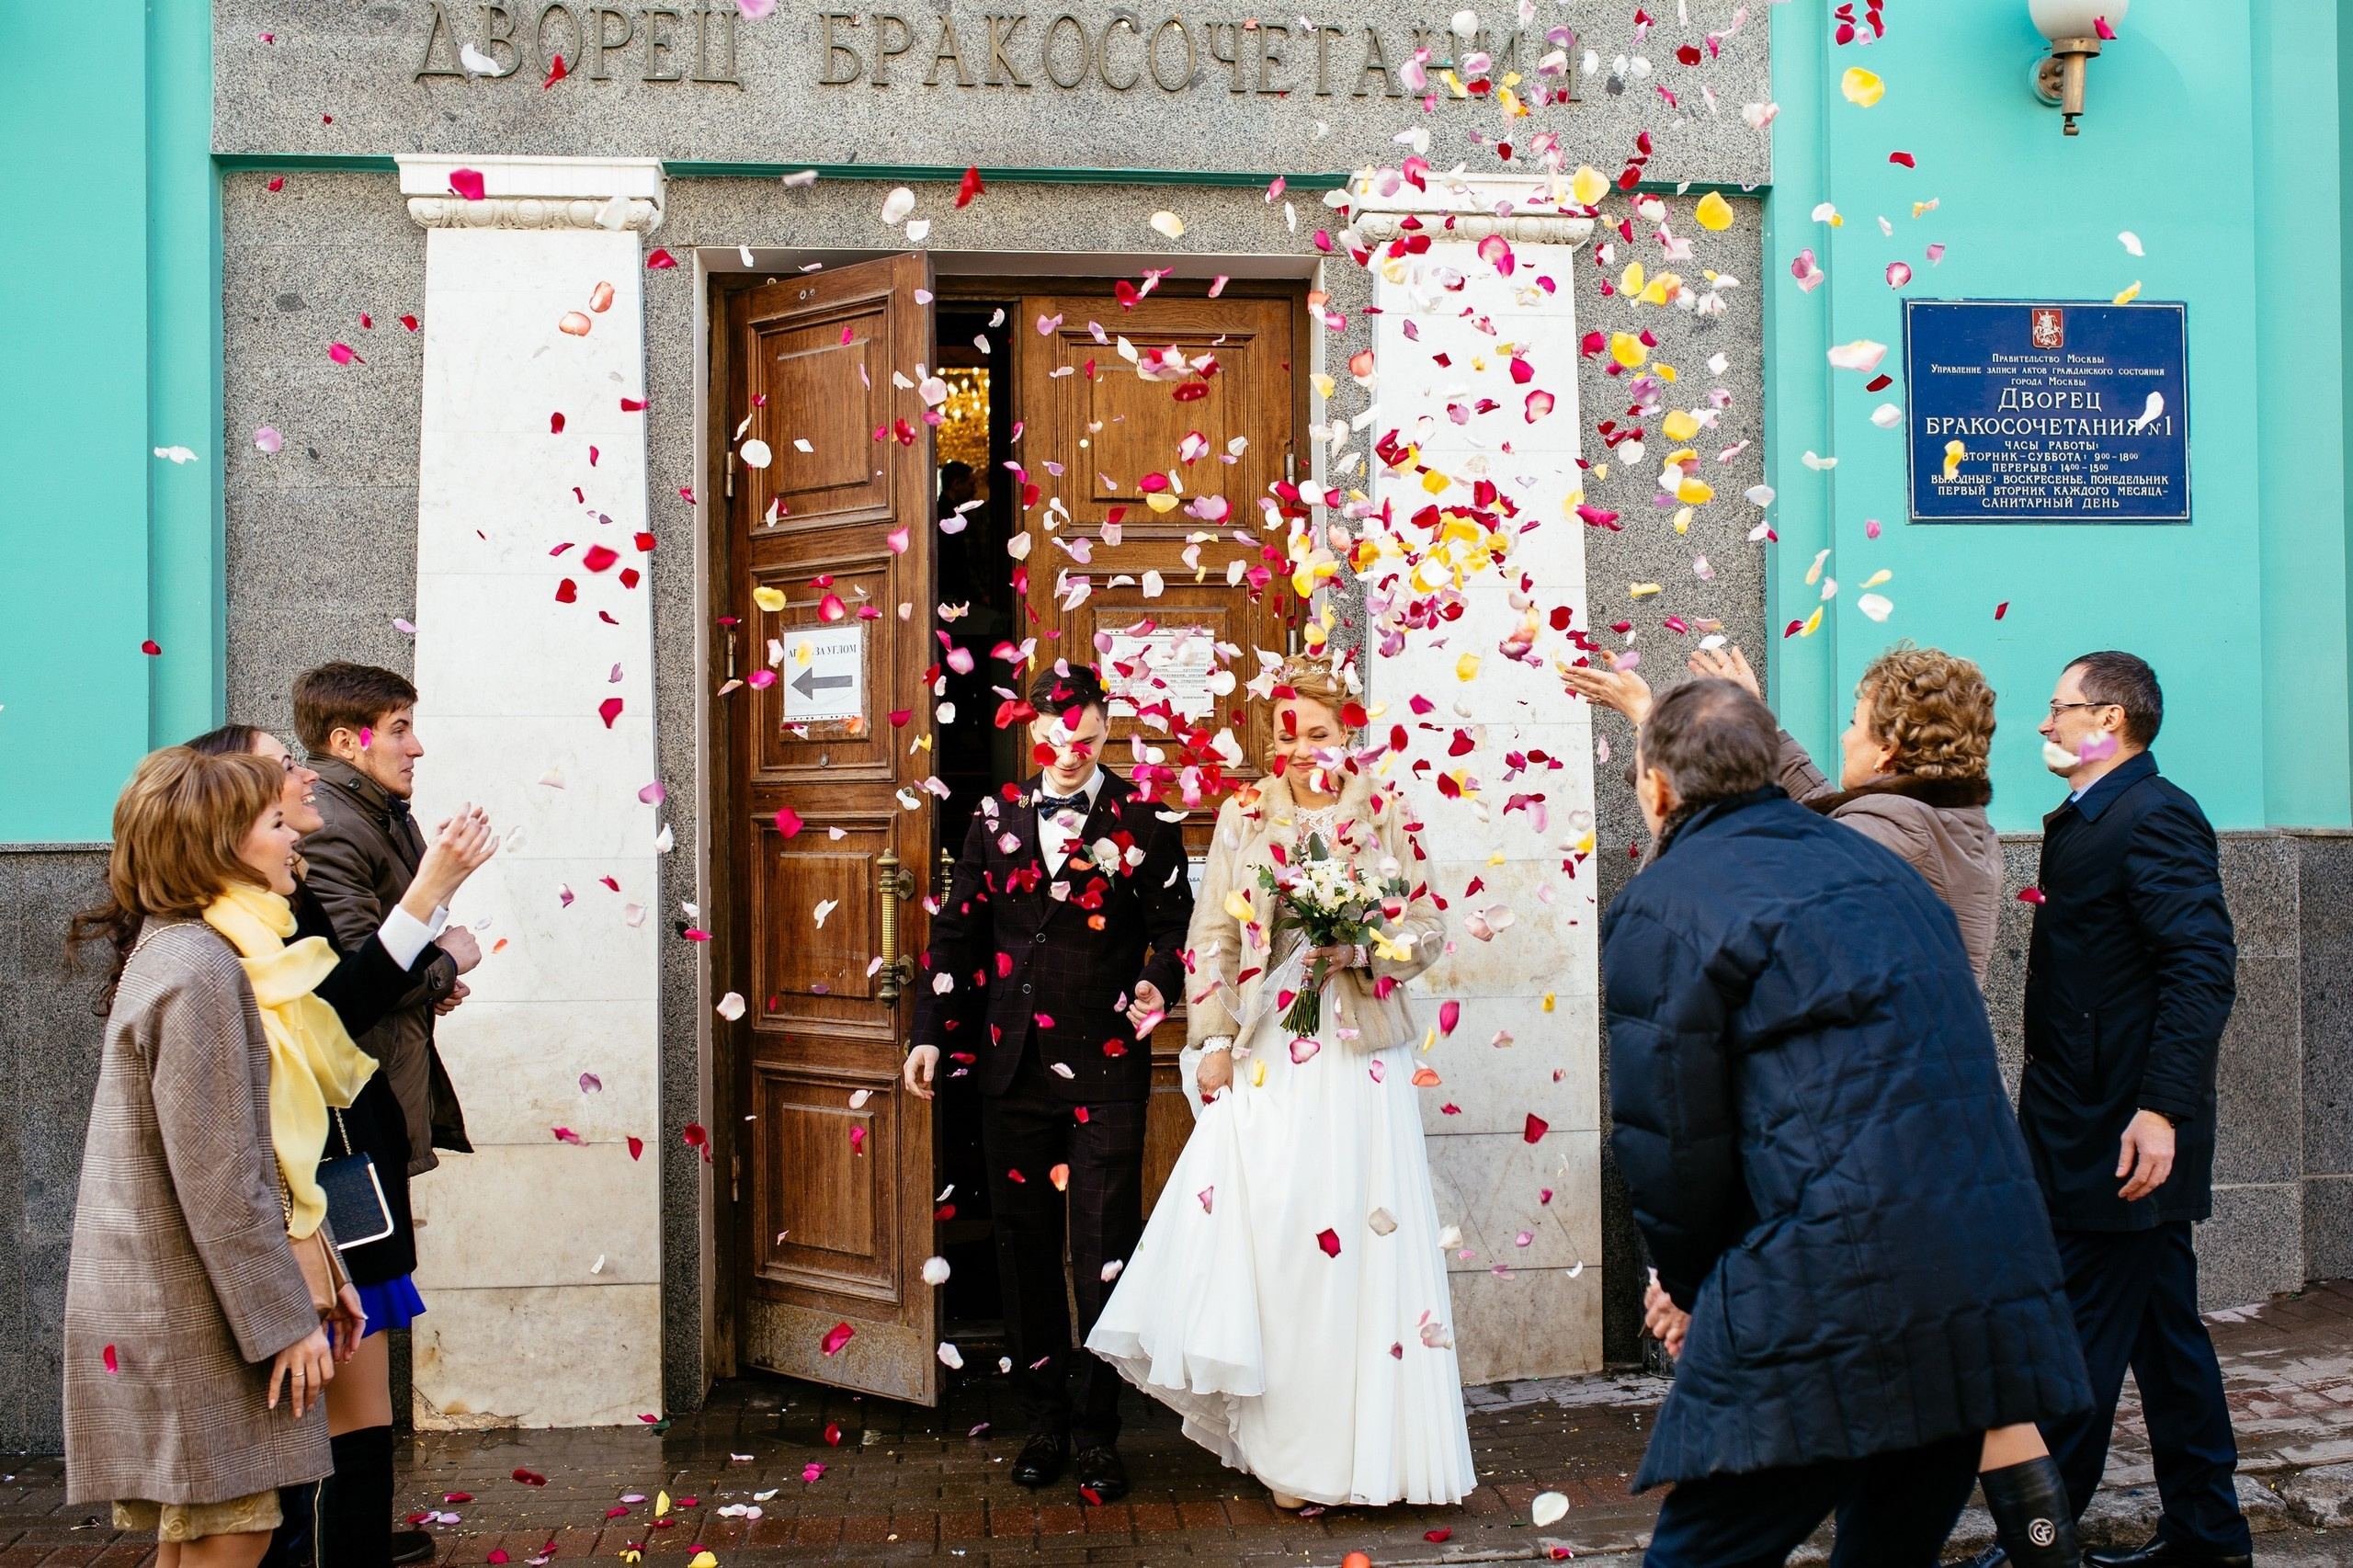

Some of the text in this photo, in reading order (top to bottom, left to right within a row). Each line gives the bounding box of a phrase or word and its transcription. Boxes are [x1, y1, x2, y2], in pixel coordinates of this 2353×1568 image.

[414, 1, 745, 91] ДВОРЕЦ
[1926, 417, 2141, 437] БРАКОСОЧЕТАНИЯ
[2005, 440, 2099, 451] ЧАСЫ РАБОТЫ:
[1992, 462, 2053, 473] ПЕРЕРЫВ:
[2090, 474, 2169, 486] ПОНЕДЕЛЬНИК
[1938, 484, 1986, 495] ПЕРВЫЙ
[1994, 486, 2046, 496] ВТОРНИК
[2053, 486, 2109, 497] КАЖДОГО
[1982, 495, 2120, 510] САНИТАРНЫЙ ДЕНЬ
[815, 646, 825, 656] ЗА
[826, 643, 857, 655] УГЛОМ
